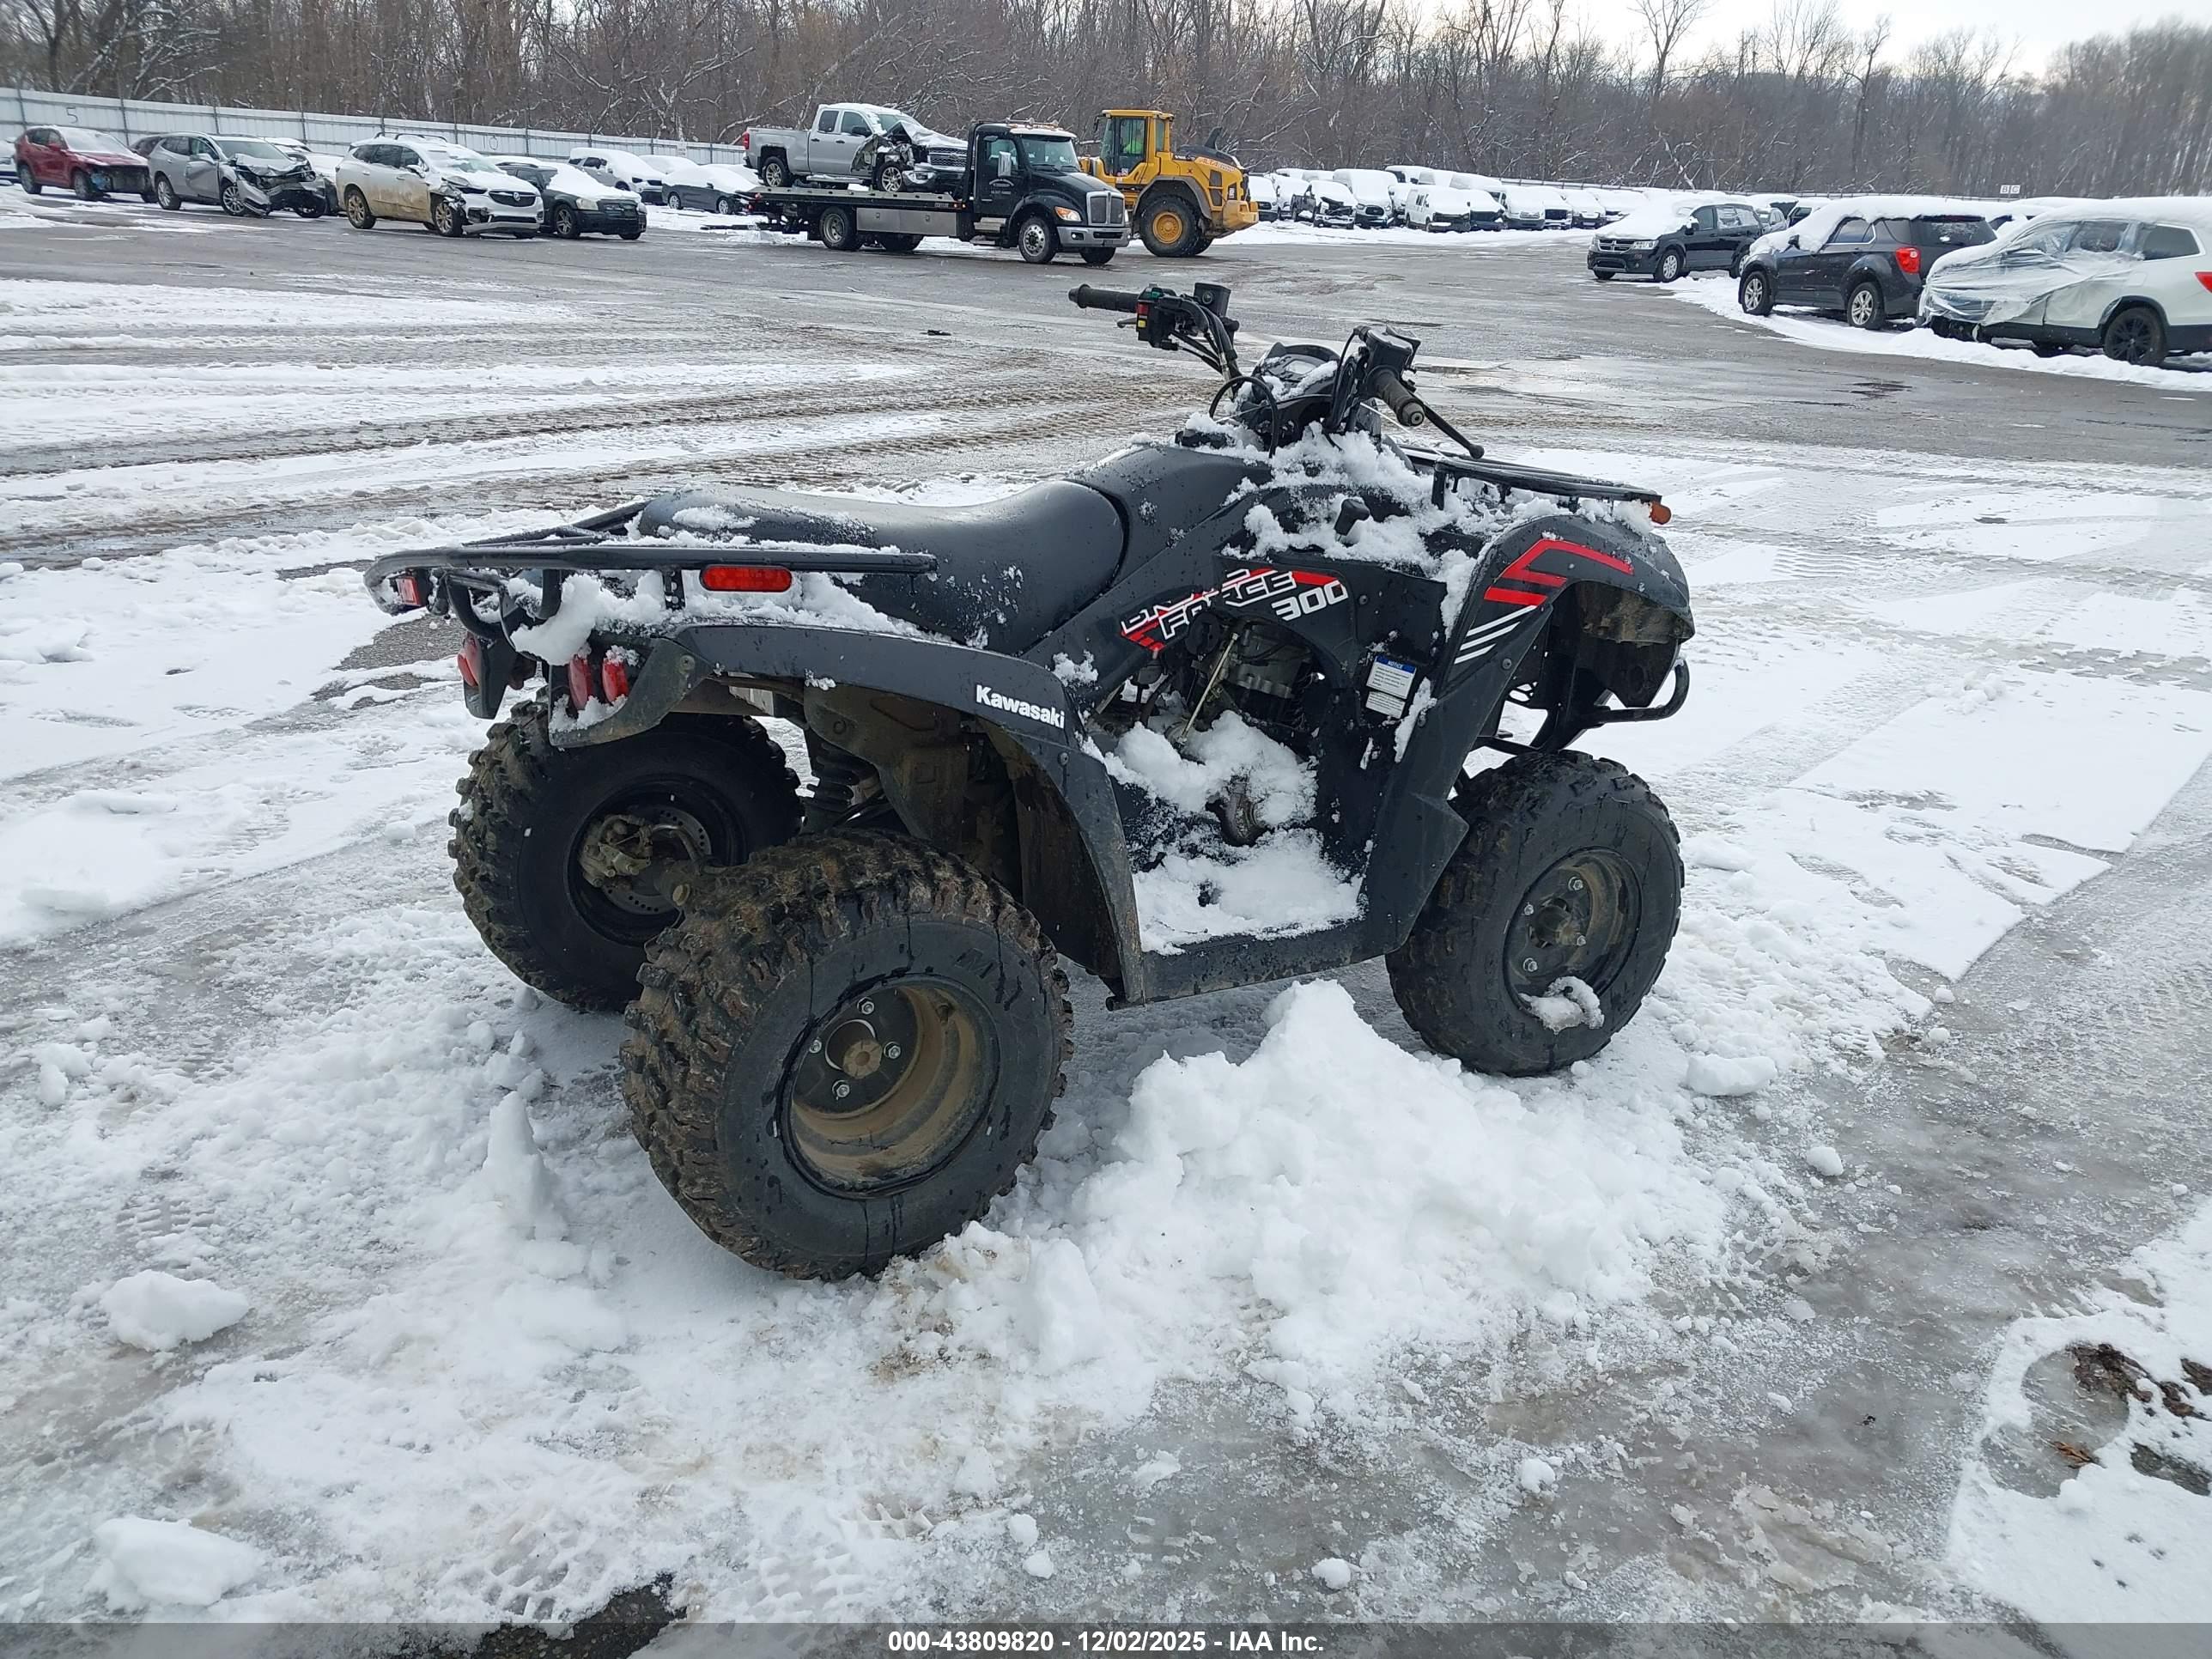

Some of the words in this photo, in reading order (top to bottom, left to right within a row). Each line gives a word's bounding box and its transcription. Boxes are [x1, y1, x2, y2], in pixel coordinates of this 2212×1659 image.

[66, 106, 78, 124] 5
[1271, 580, 1349, 621] 300
[975, 684, 1066, 729] Kawasaki
